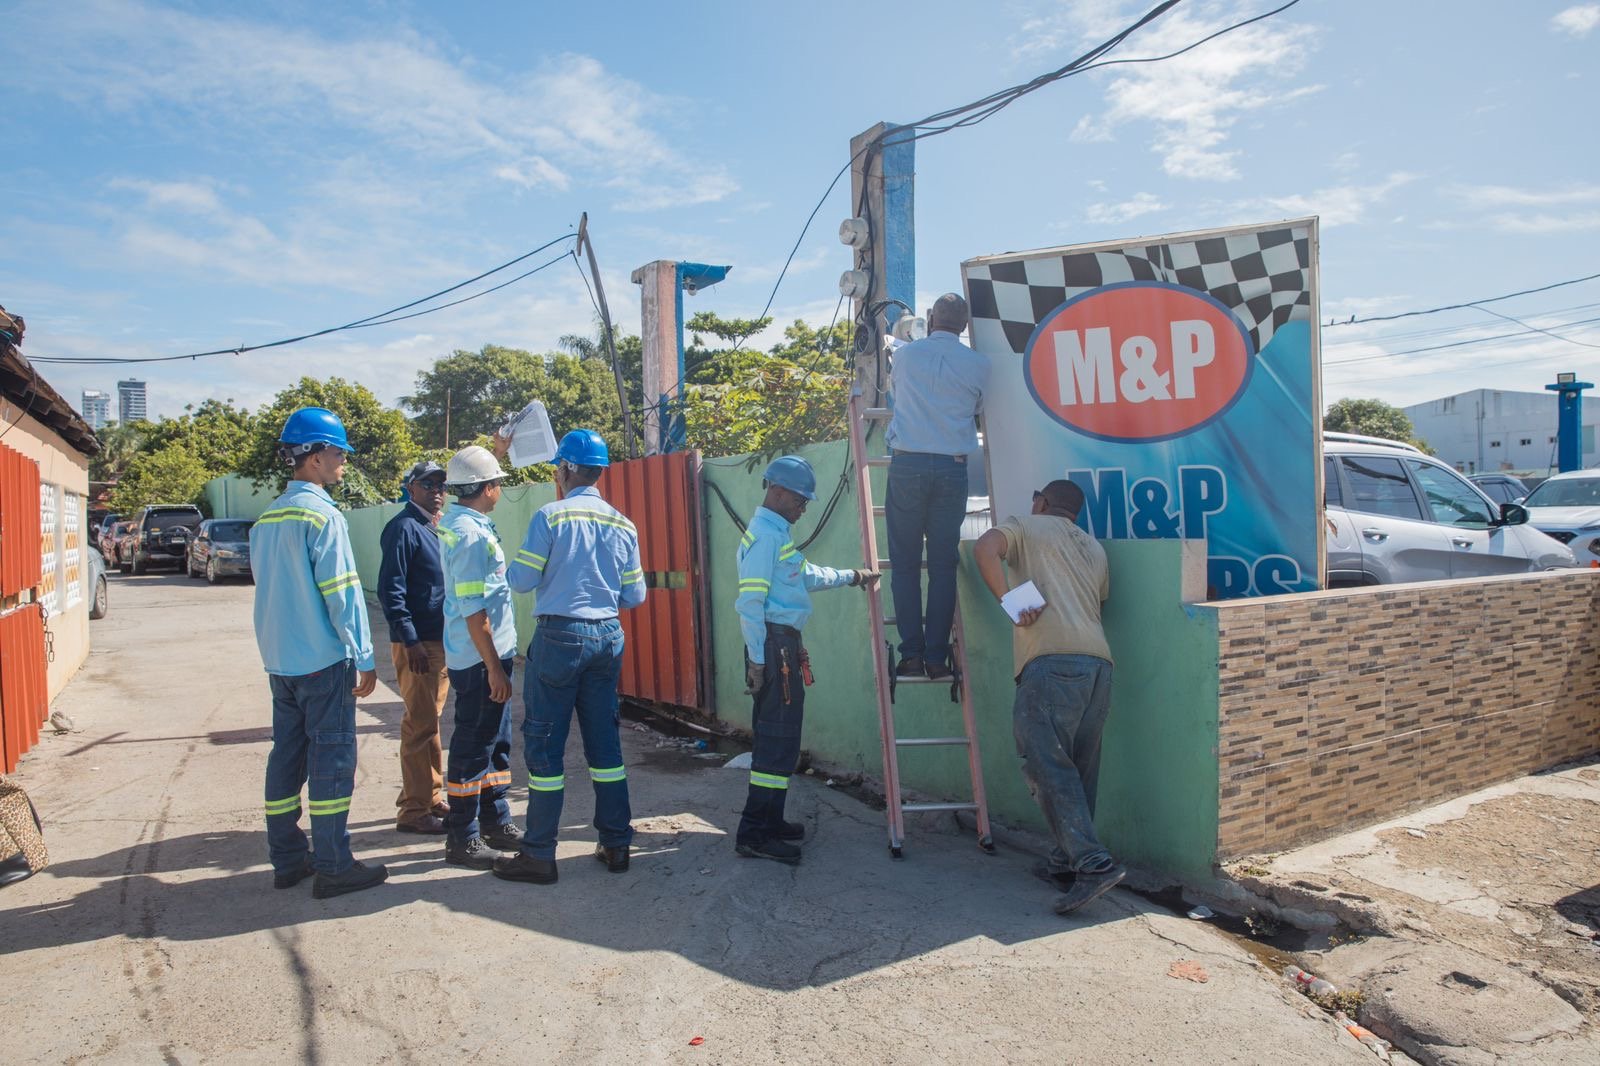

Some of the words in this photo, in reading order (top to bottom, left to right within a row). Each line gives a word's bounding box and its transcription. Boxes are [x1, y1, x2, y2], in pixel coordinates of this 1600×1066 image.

[1053, 319, 1216, 406] M&P
[1066, 465, 1228, 540] M&P
[1207, 554, 1302, 599] RS
